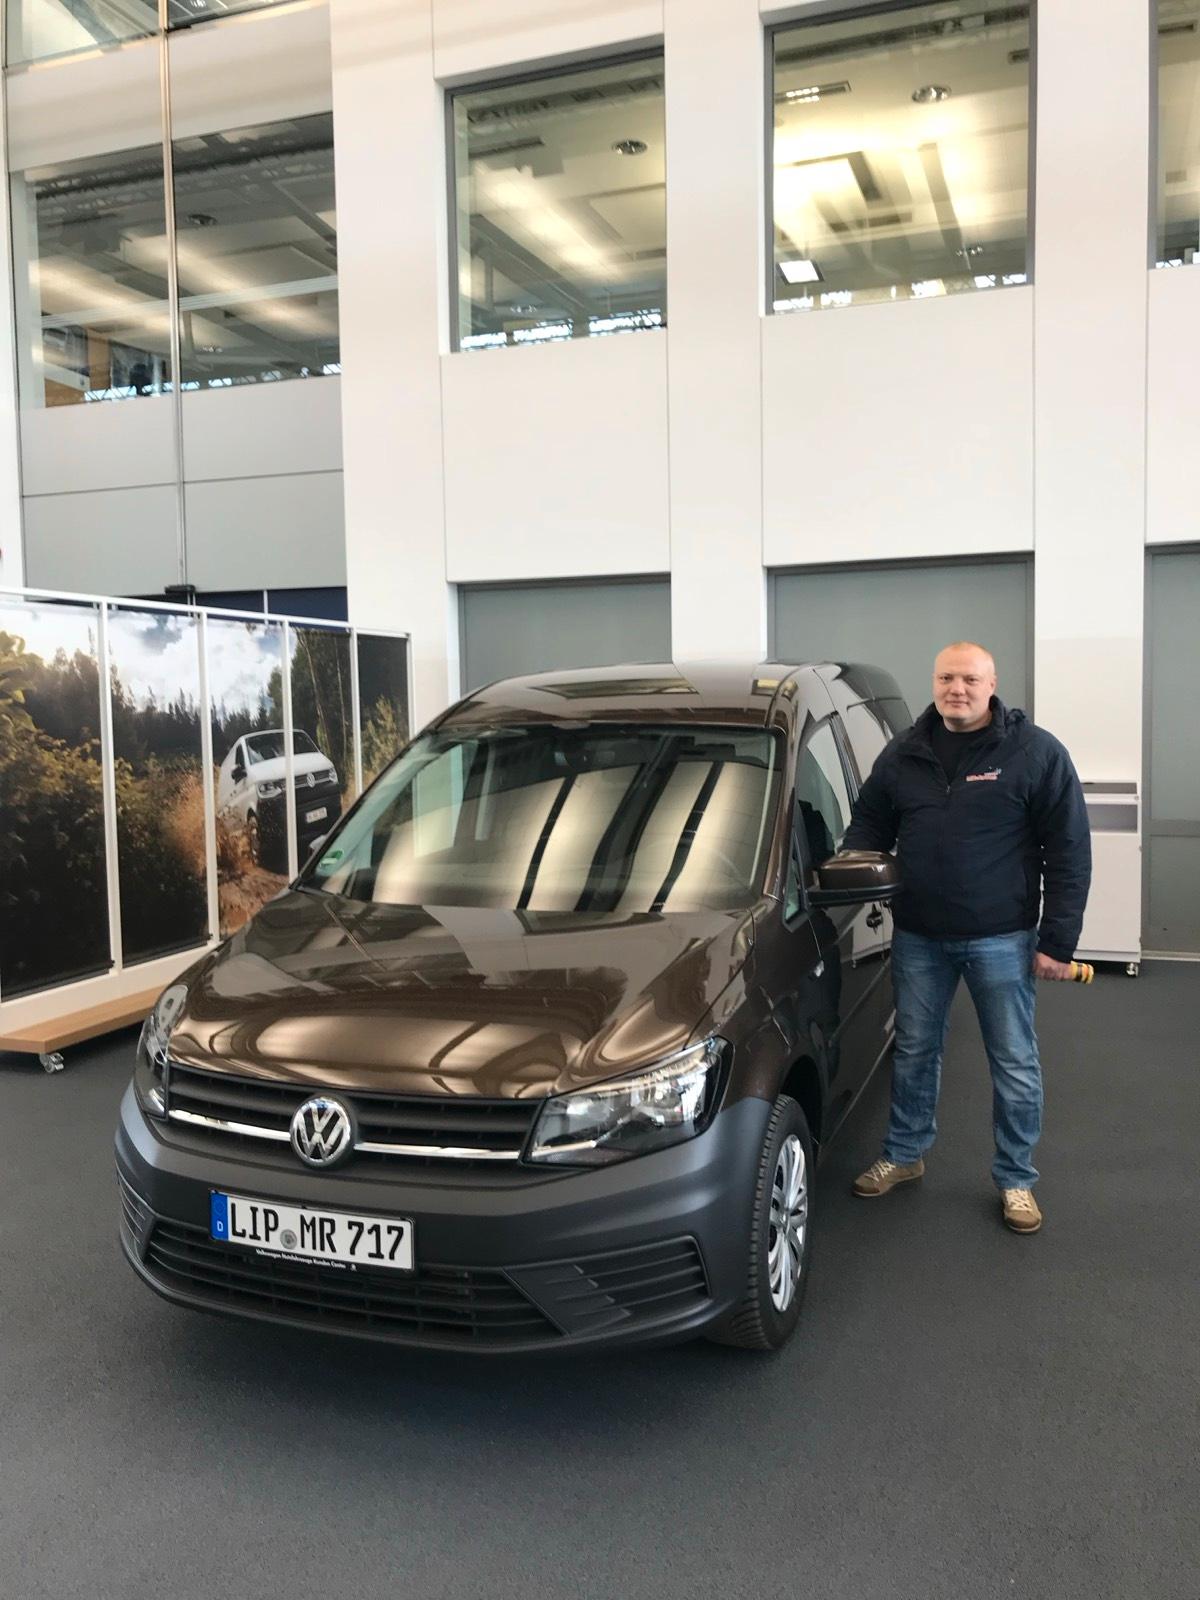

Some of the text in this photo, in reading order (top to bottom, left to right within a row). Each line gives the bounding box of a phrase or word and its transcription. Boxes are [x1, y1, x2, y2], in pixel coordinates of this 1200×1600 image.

[293, 1099, 351, 1162] VW
[217, 1220, 224, 1232] D
[230, 1202, 279, 1243] LIP
[300, 1213, 337, 1253] MR
[347, 1221, 405, 1260] 717
